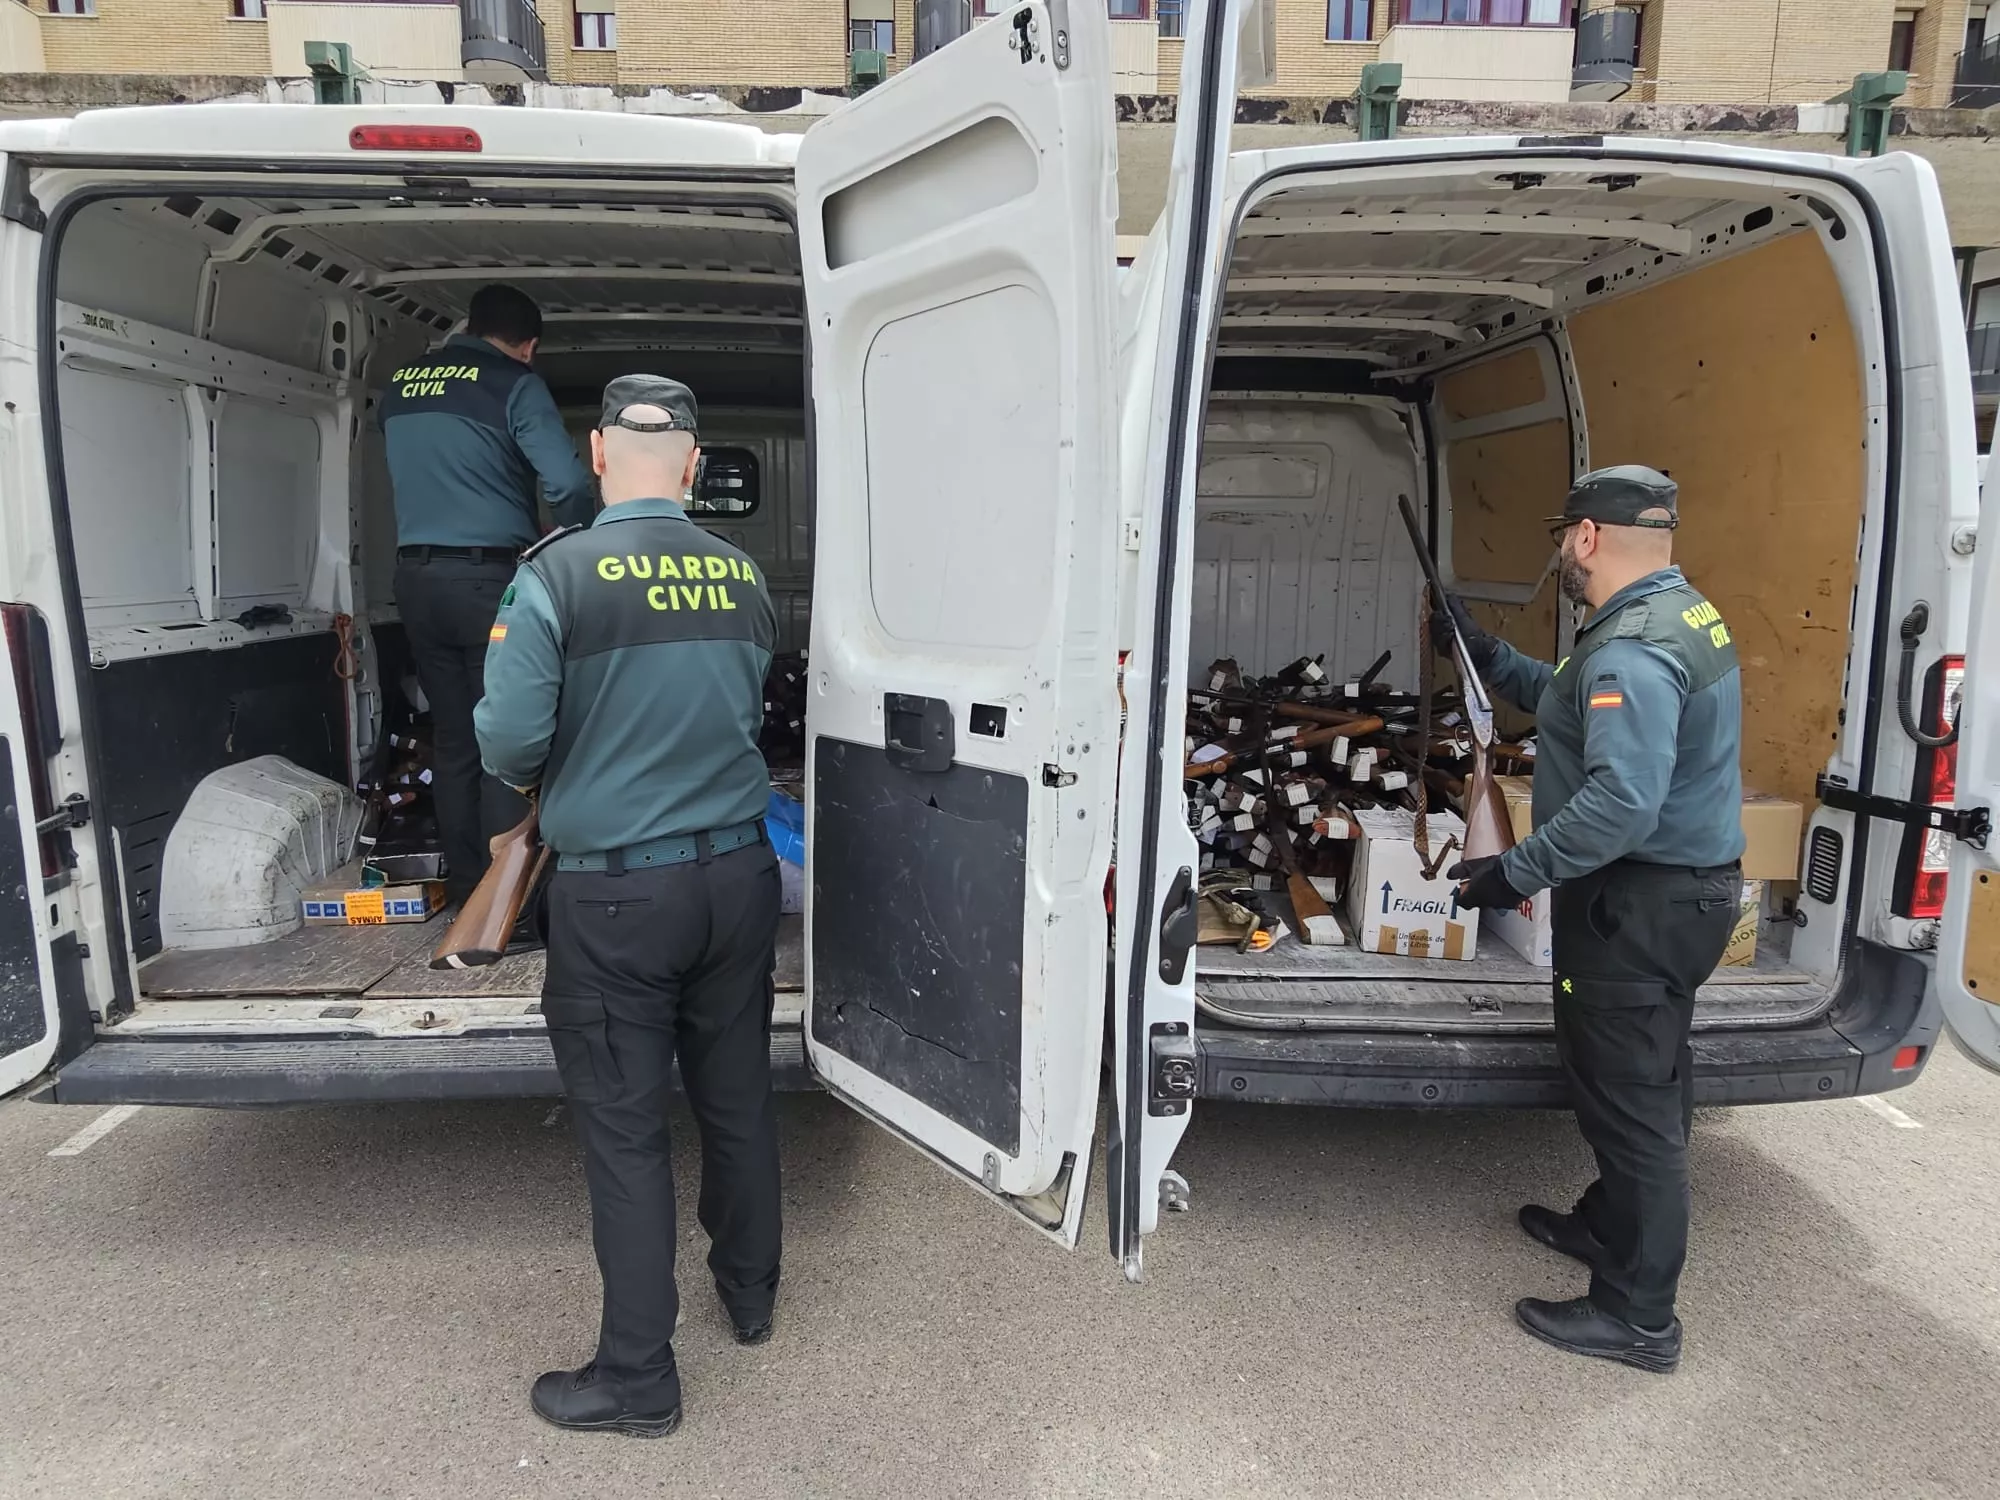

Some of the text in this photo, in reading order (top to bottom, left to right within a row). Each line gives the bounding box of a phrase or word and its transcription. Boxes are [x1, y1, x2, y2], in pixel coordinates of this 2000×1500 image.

[392, 365, 479, 382] GUARDIA
[401, 381, 446, 398] CIVIL
[597, 555, 757, 586] GUARDIA
[647, 585, 737, 611] CIVIL
[1393, 898, 1448, 915] FRAGIL
[350, 915, 383, 924] ARMAS
